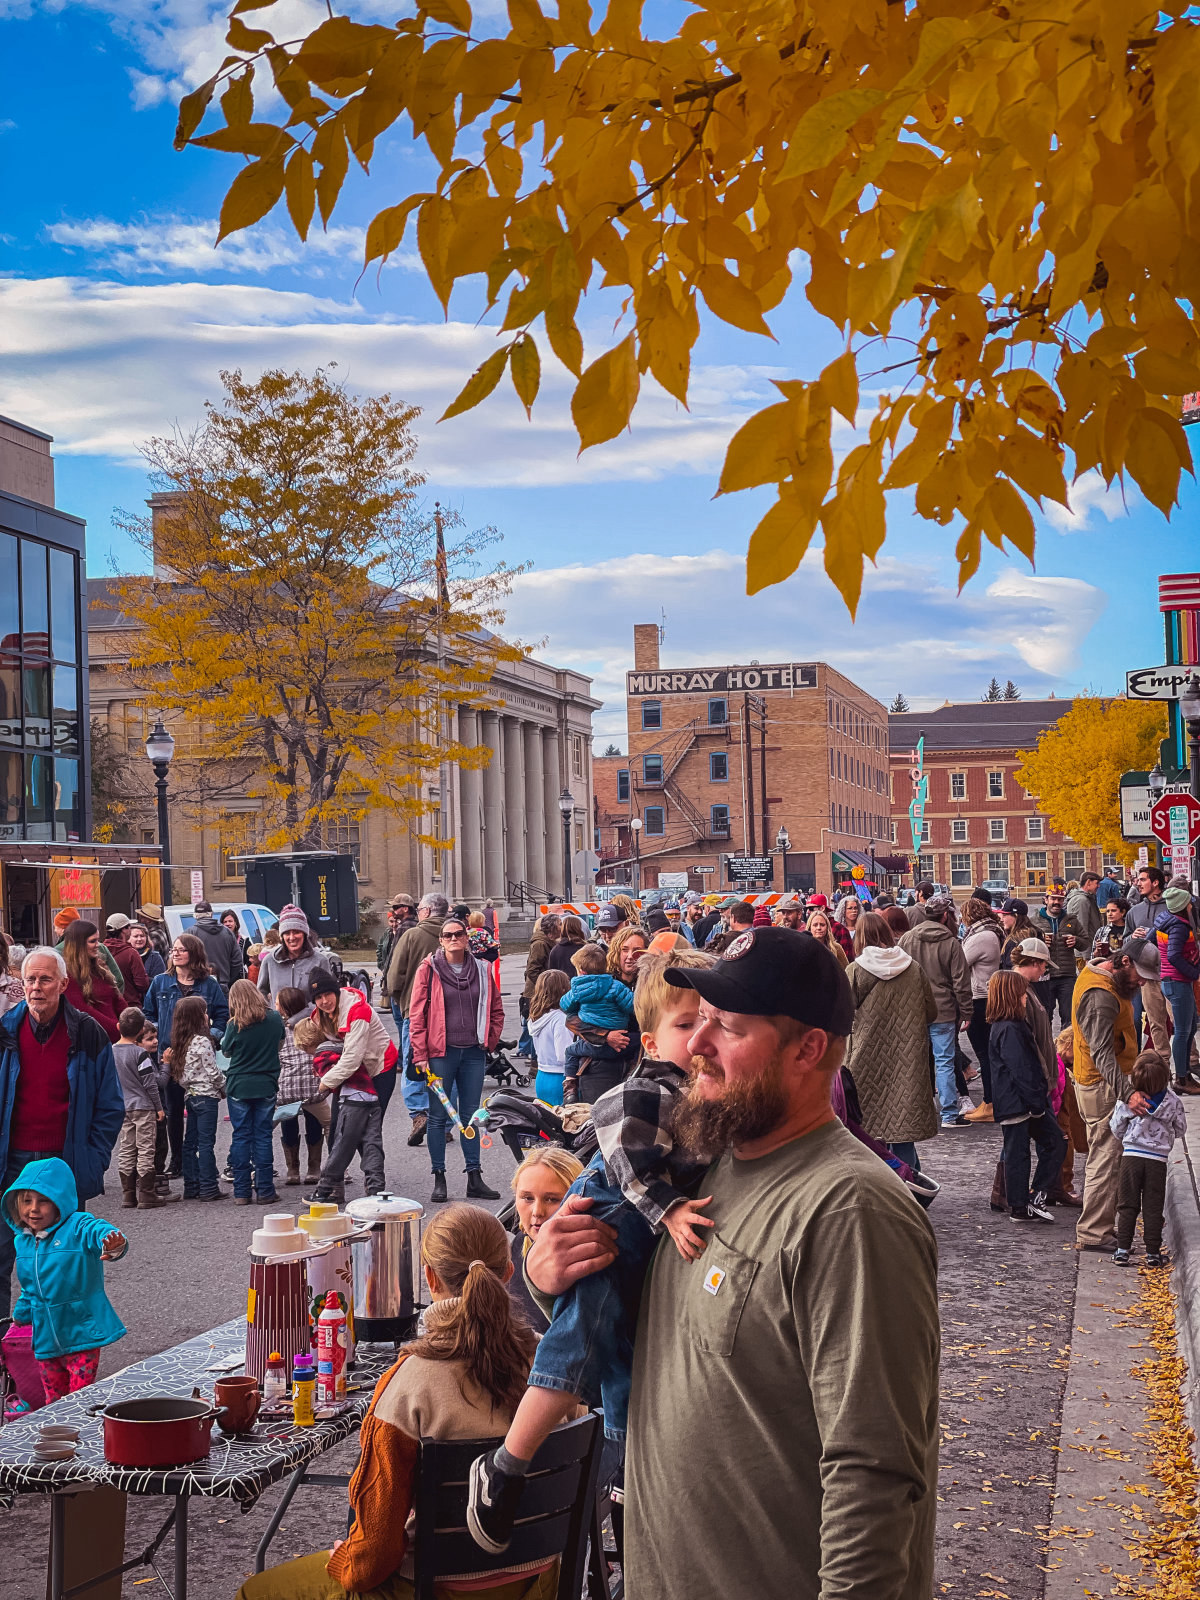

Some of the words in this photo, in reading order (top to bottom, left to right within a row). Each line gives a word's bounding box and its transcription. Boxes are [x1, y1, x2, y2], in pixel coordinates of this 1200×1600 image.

[629, 671, 720, 693] MURRAY
[727, 668, 810, 689] HOTEL
[1129, 669, 1191, 696] Empi
[910, 749, 923, 836] HOTEL
[1154, 809, 1200, 830] SP
[1170, 808, 1176, 819] 2
[1176, 847, 1185, 855] NO
[318, 875, 328, 916] WANCO
